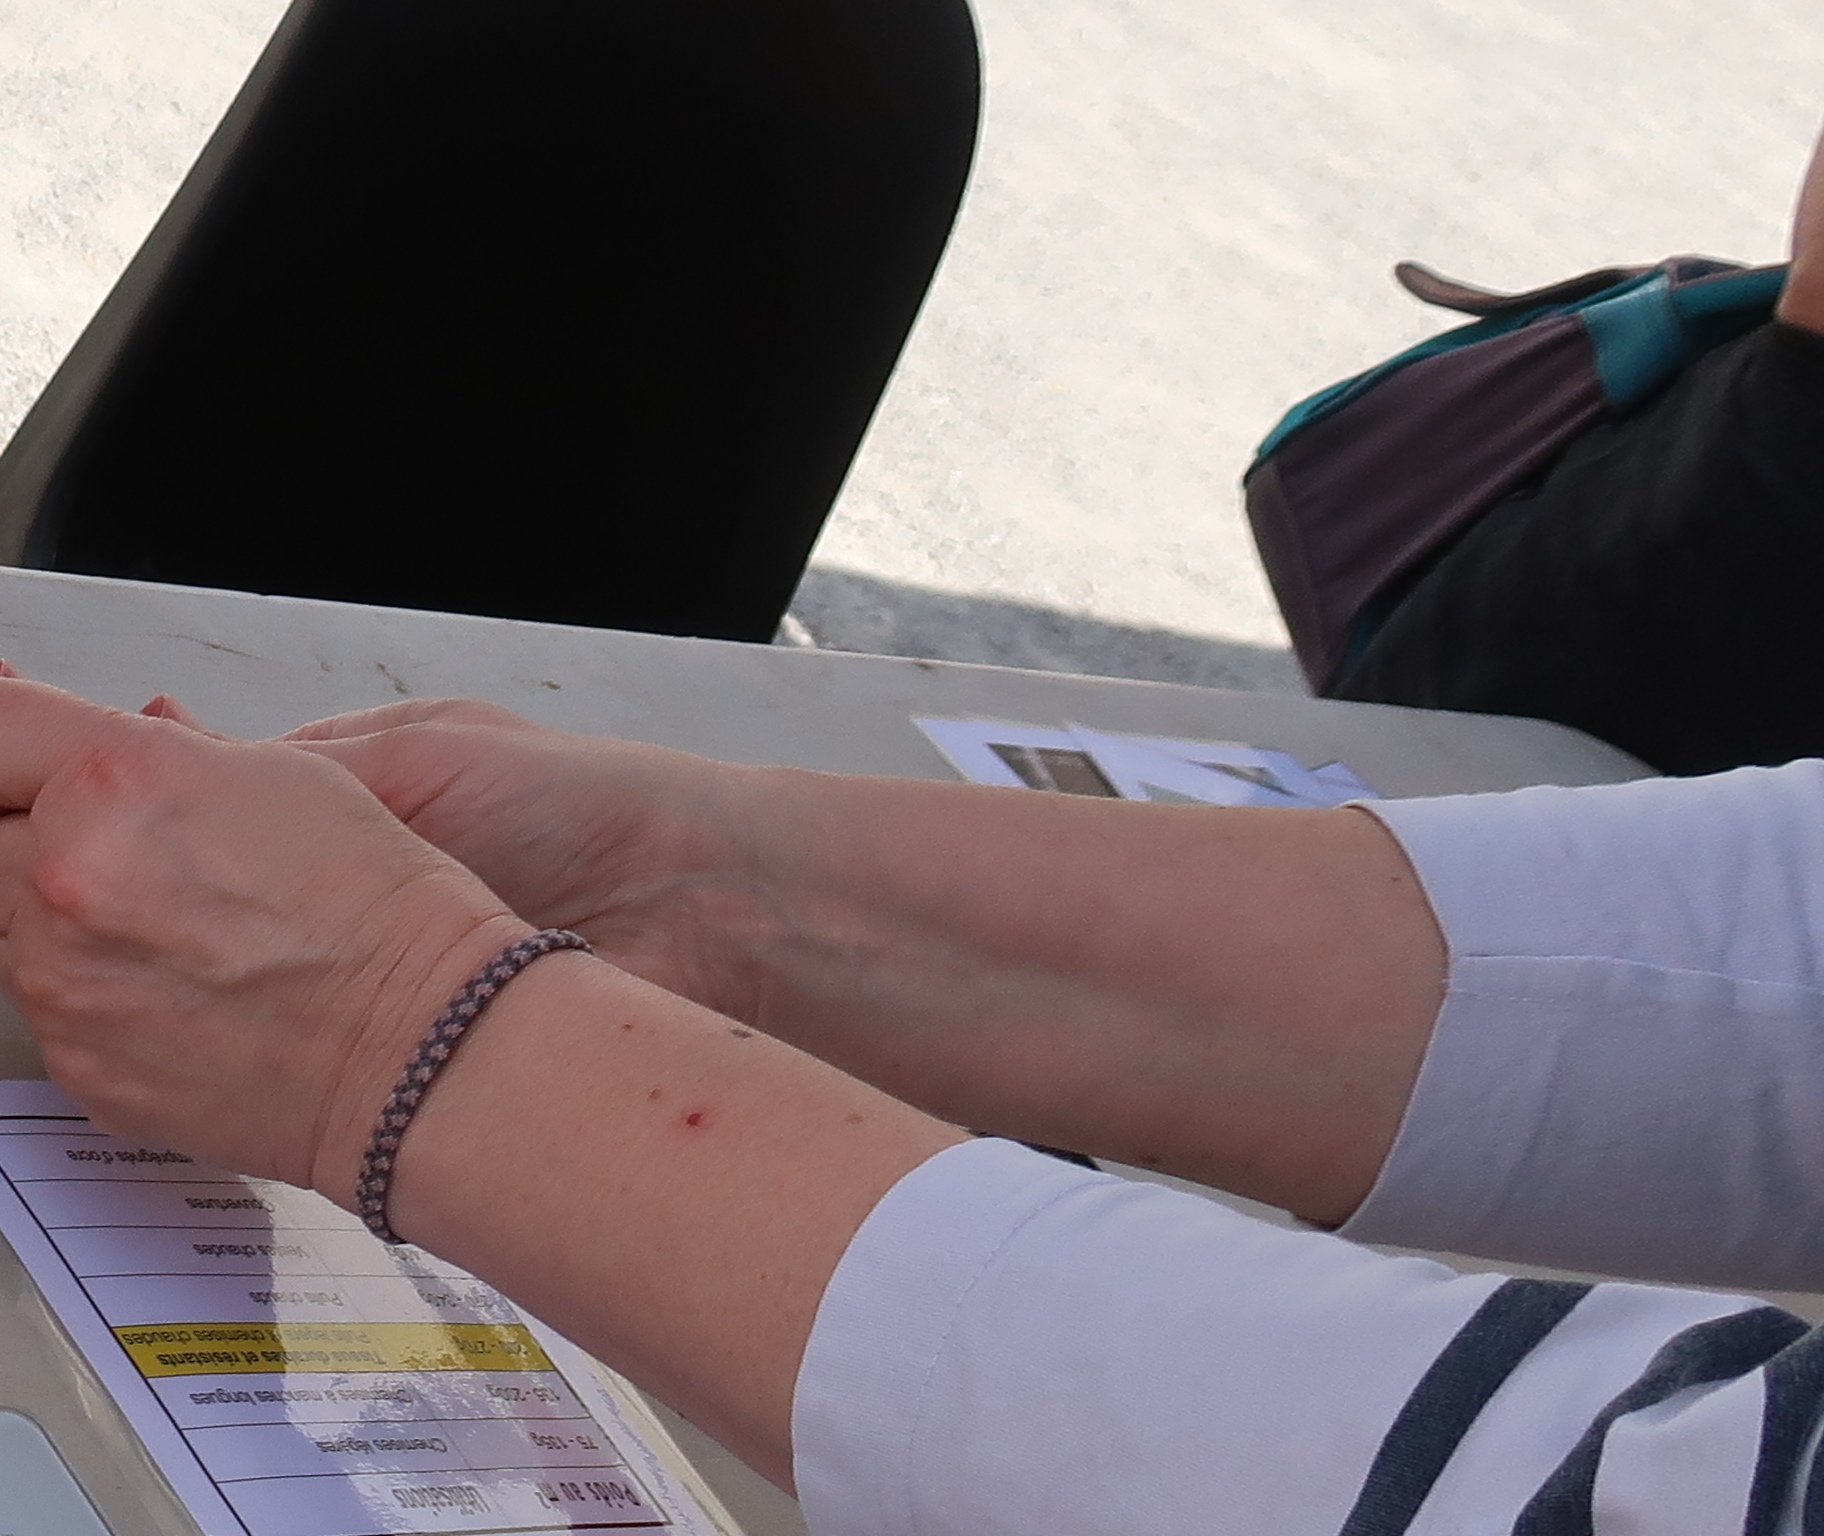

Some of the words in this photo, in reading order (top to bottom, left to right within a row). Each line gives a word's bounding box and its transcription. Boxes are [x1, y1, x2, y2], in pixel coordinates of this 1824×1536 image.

[116, 1149, 195, 1166] mprégnés
[185, 1197, 275, 1213] Couvertures
[193, 1243, 255, 1258] chaudes
[122, 1329, 192, 1347] chaudes
[194, 1329, 265, 1344] chemises
[158, 1351, 240, 1367] résistants
[244, 1351, 259, 1365] et
[189, 1388, 253, 1405] longues
[316, 1438, 374, 1455] légères
[372, 1437, 448, 1454] Chemises
[576, 1435, 600, 1451] 75
[559, 1480, 586, 1501] au
[588, 1480, 643, 1509] Poids
[392, 1484, 490, 1517] Utilisations
